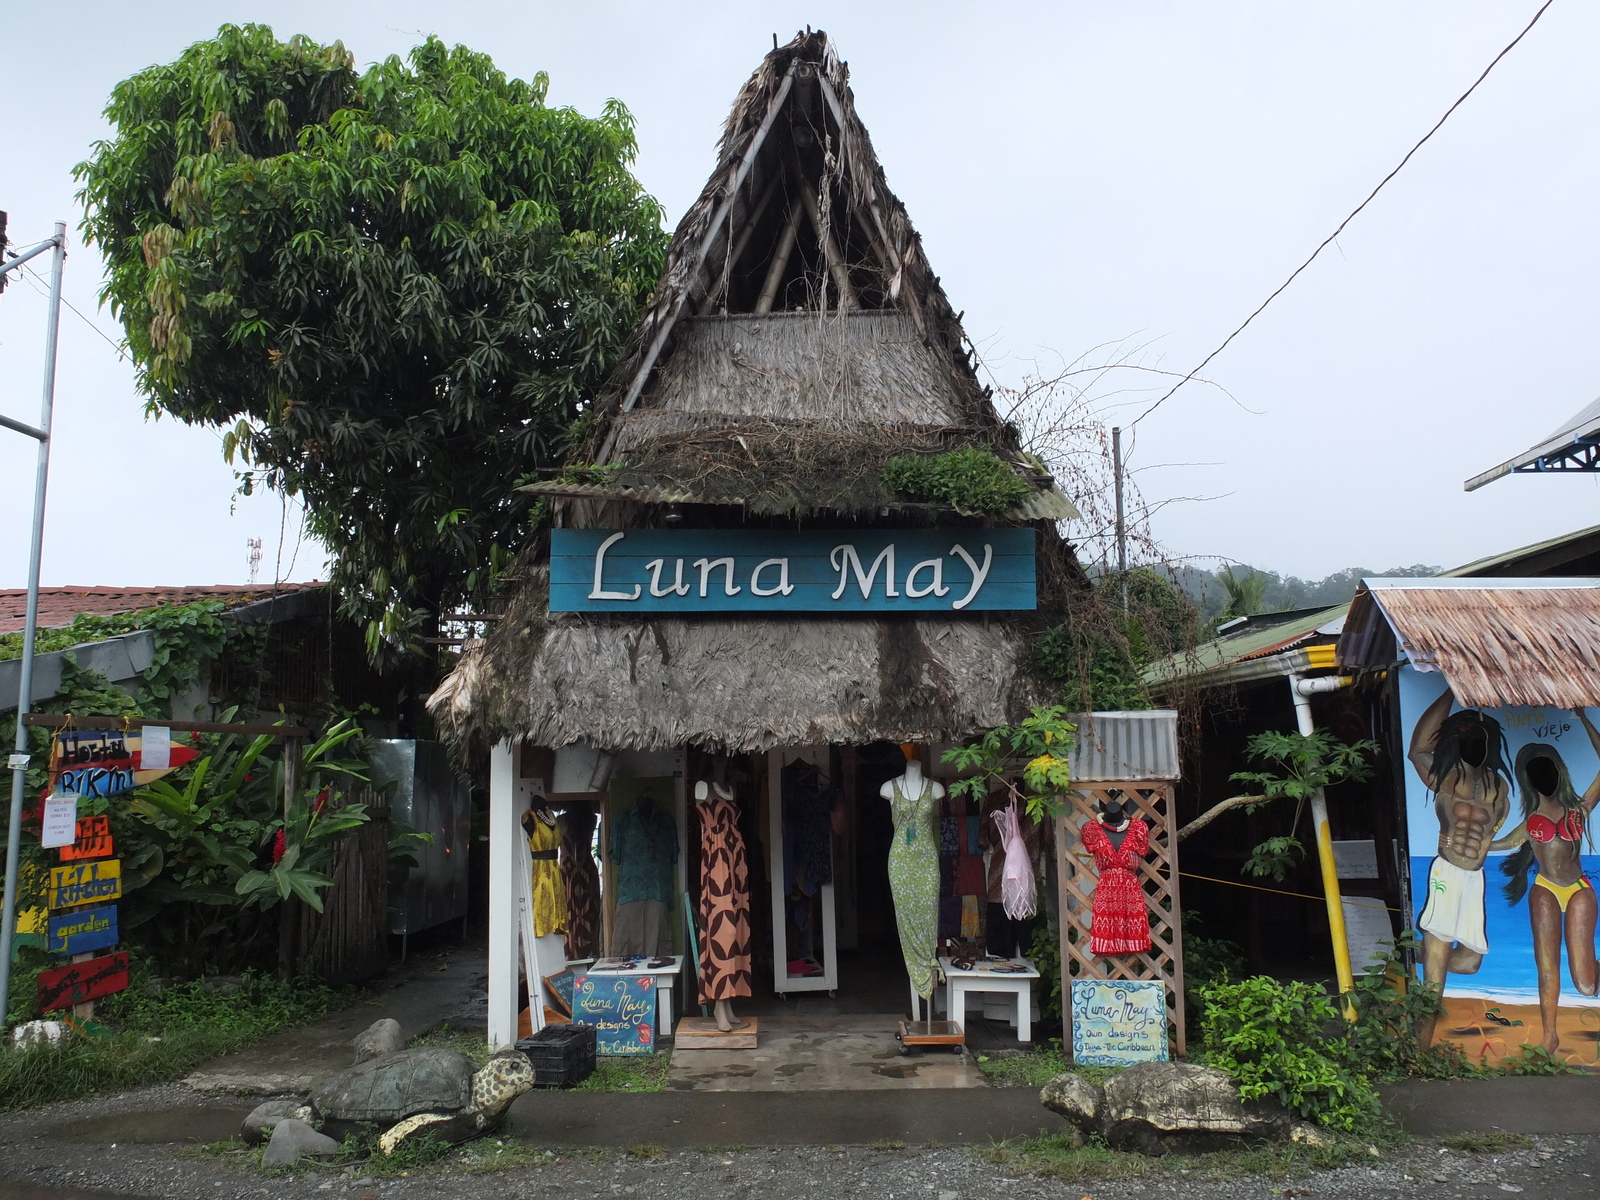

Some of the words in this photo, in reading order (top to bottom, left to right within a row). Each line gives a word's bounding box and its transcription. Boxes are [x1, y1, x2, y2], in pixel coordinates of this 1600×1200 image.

[588, 532, 794, 600] Luna
[829, 543, 993, 609] May
[48, 915, 110, 953] garden
[581, 982, 614, 1012] Luna
[614, 979, 652, 1025] May
[1080, 987, 1119, 1023] Luna
[1115, 989, 1155, 1030] May
[596, 1018, 631, 1034] designs
[1086, 1030, 1102, 1038] Own
[1108, 1026, 1149, 1041] designs
[599, 1041, 612, 1054] The
[1117, 1042, 1156, 1052] Caribbean
